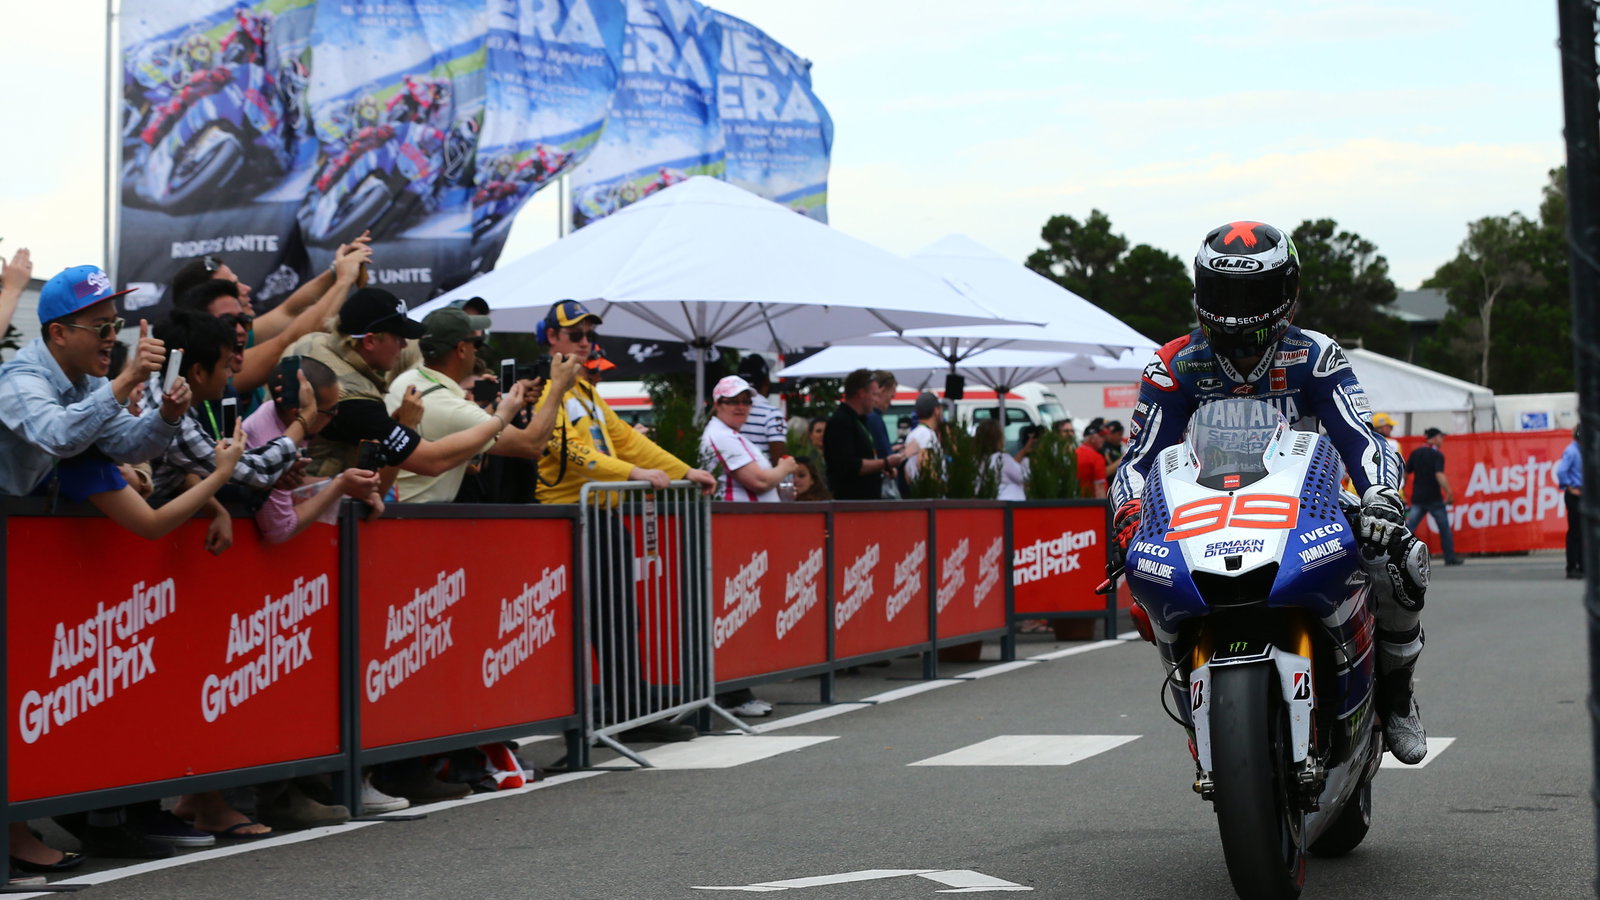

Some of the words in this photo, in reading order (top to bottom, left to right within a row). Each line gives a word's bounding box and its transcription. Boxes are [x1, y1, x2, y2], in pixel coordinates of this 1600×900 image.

[717, 74, 821, 123] ERA
[225, 235, 279, 252] UNITE
[379, 267, 432, 284] UNITE
[1215, 259, 1255, 269] HJC
[1200, 308, 1225, 324] SECTOR
[1237, 312, 1270, 325] SECTOR
[1283, 350, 1308, 360] YAMAHA
[1208, 429, 1273, 441] SEMAK
[1164, 493, 1299, 542] 99
[1299, 523, 1343, 544] IVECO
[1013, 530, 1096, 566] ustralian
[1043, 553, 1081, 578] Prix
[1133, 542, 1170, 558] IVECO
[1218, 546, 1263, 555] DEPAN
[1298, 538, 1343, 563] YAMALUBE
[724, 549, 768, 610] Australian
[785, 547, 823, 604] Australian
[1137, 558, 1174, 579] YAMALUBE
[225, 573, 329, 664] Australian
[385, 568, 465, 650] Australian
[498, 564, 566, 640] Australian
[49, 577, 175, 678] Australian
[366, 628, 420, 702] Grand
[421, 614, 453, 666] Prix
[482, 622, 528, 688] Grand
[529, 607, 556, 655] Prix
[19, 645, 105, 744] Grand
[106, 634, 156, 698] Prix
[201, 638, 270, 722] Grand
[271, 624, 313, 682] Prix
